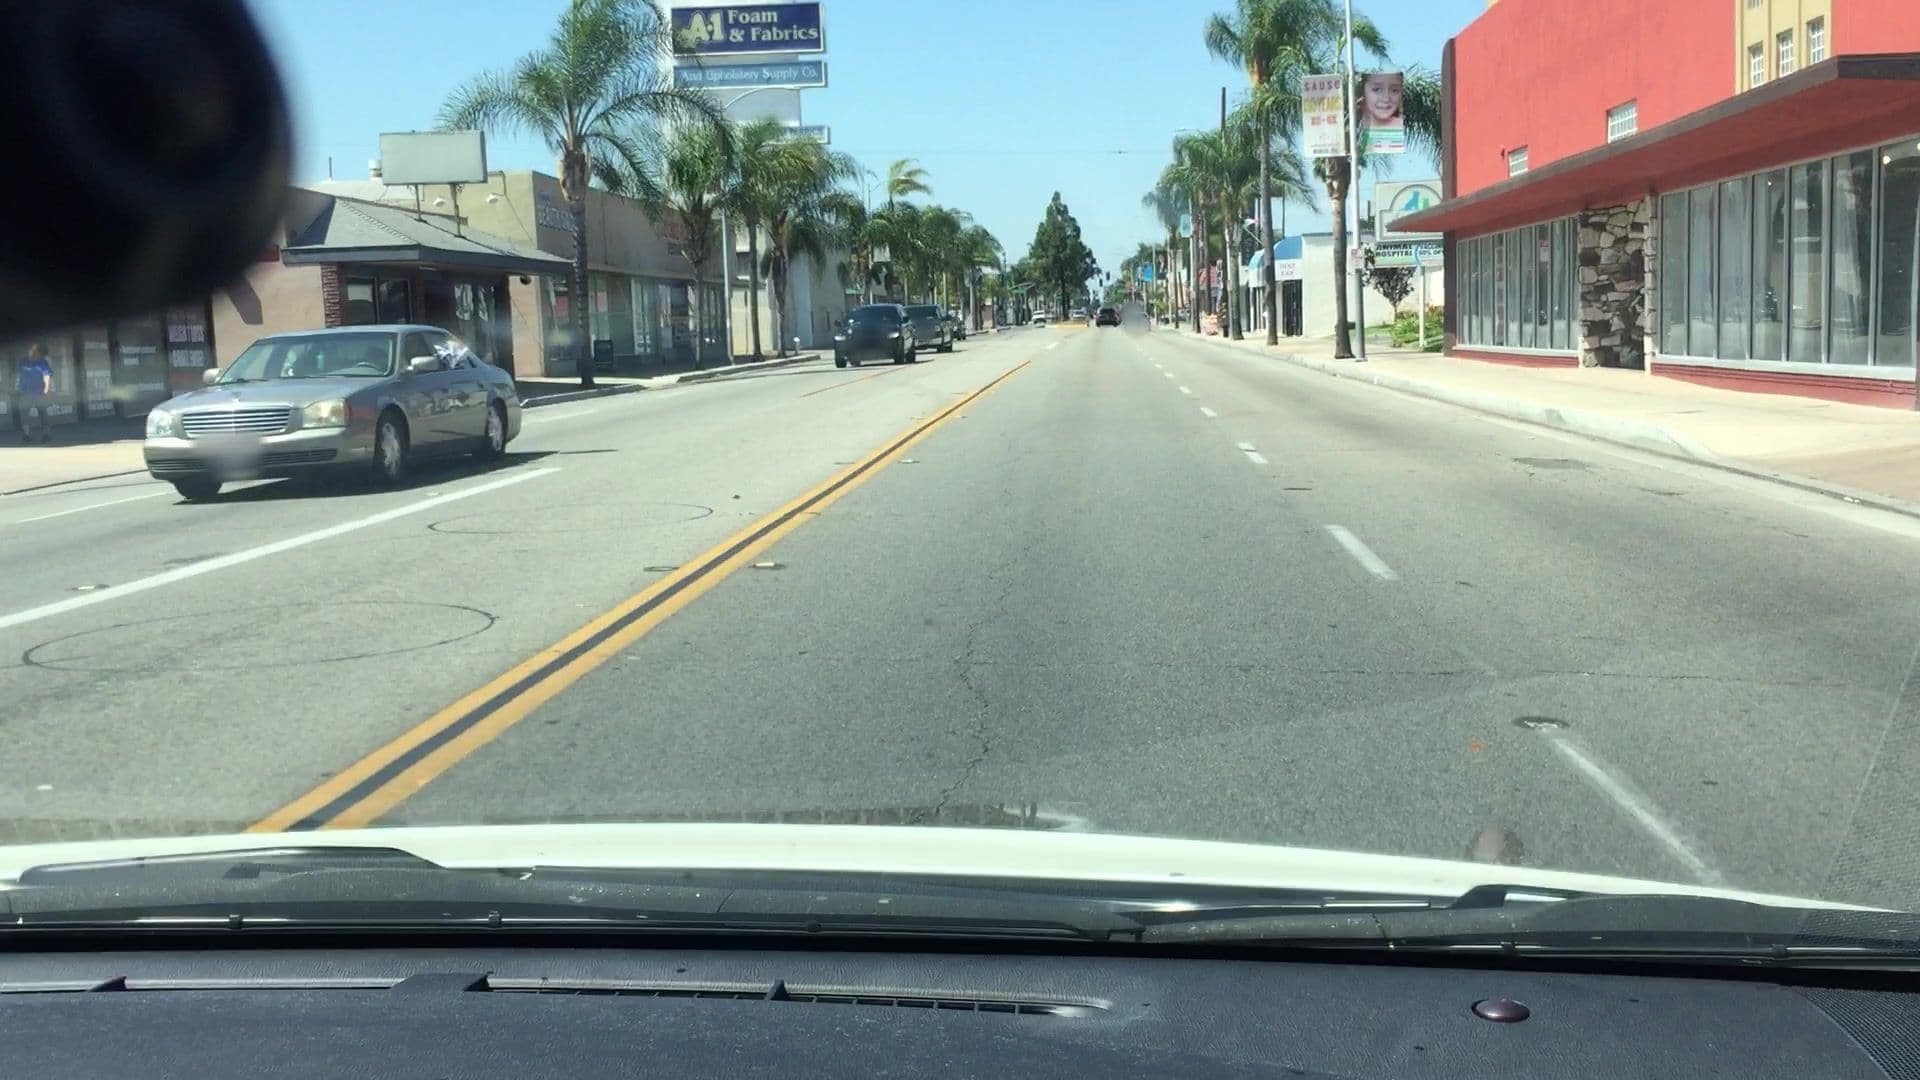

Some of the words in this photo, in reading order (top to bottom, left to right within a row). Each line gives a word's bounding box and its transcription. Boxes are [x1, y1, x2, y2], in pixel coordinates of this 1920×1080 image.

[727, 9, 778, 24] Foam
[729, 28, 745, 42] &
[751, 24, 819, 41] Fabrics
[762, 67, 798, 80] Supply
